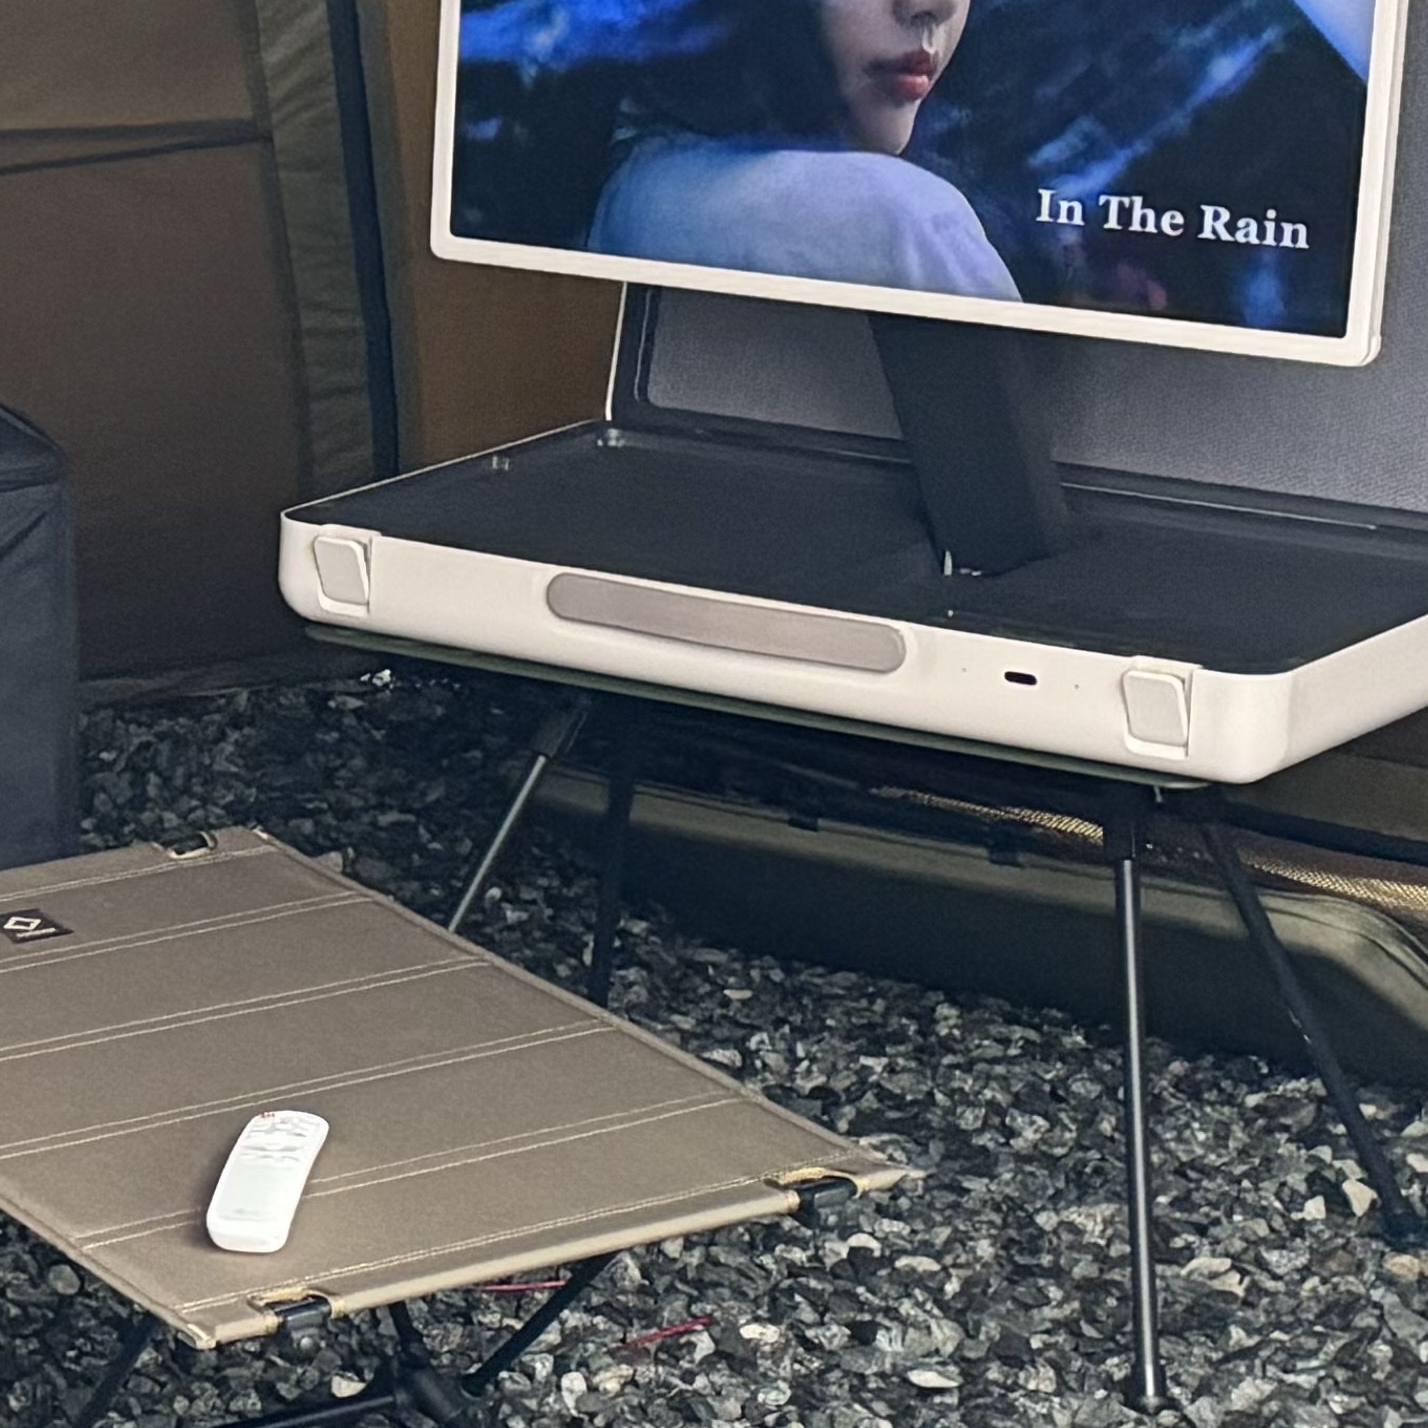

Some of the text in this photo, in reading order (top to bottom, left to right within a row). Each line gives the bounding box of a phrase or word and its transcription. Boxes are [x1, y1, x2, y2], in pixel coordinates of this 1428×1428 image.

[1036, 188, 1310, 249] In The Rain
